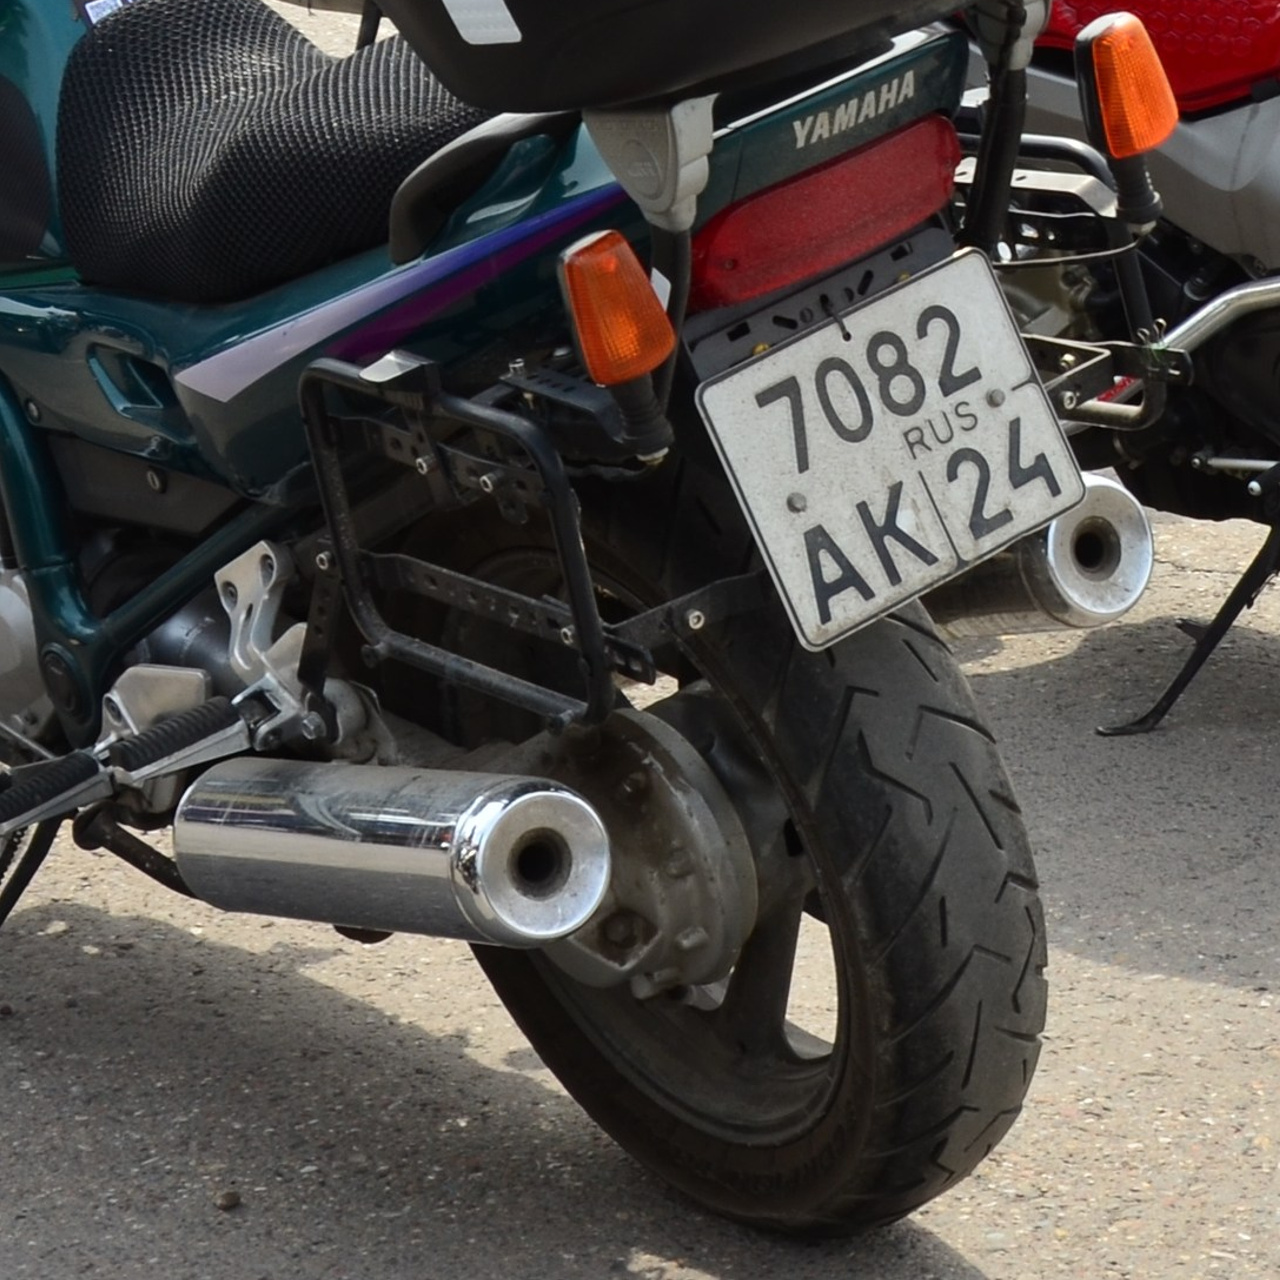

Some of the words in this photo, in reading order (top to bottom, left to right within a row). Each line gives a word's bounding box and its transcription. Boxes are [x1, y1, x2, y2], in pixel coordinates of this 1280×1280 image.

[792, 70, 915, 149] YAMAHA
[755, 304, 982, 474] 7082
[903, 401, 979, 460] RUS
[946, 417, 1062, 541] 24
